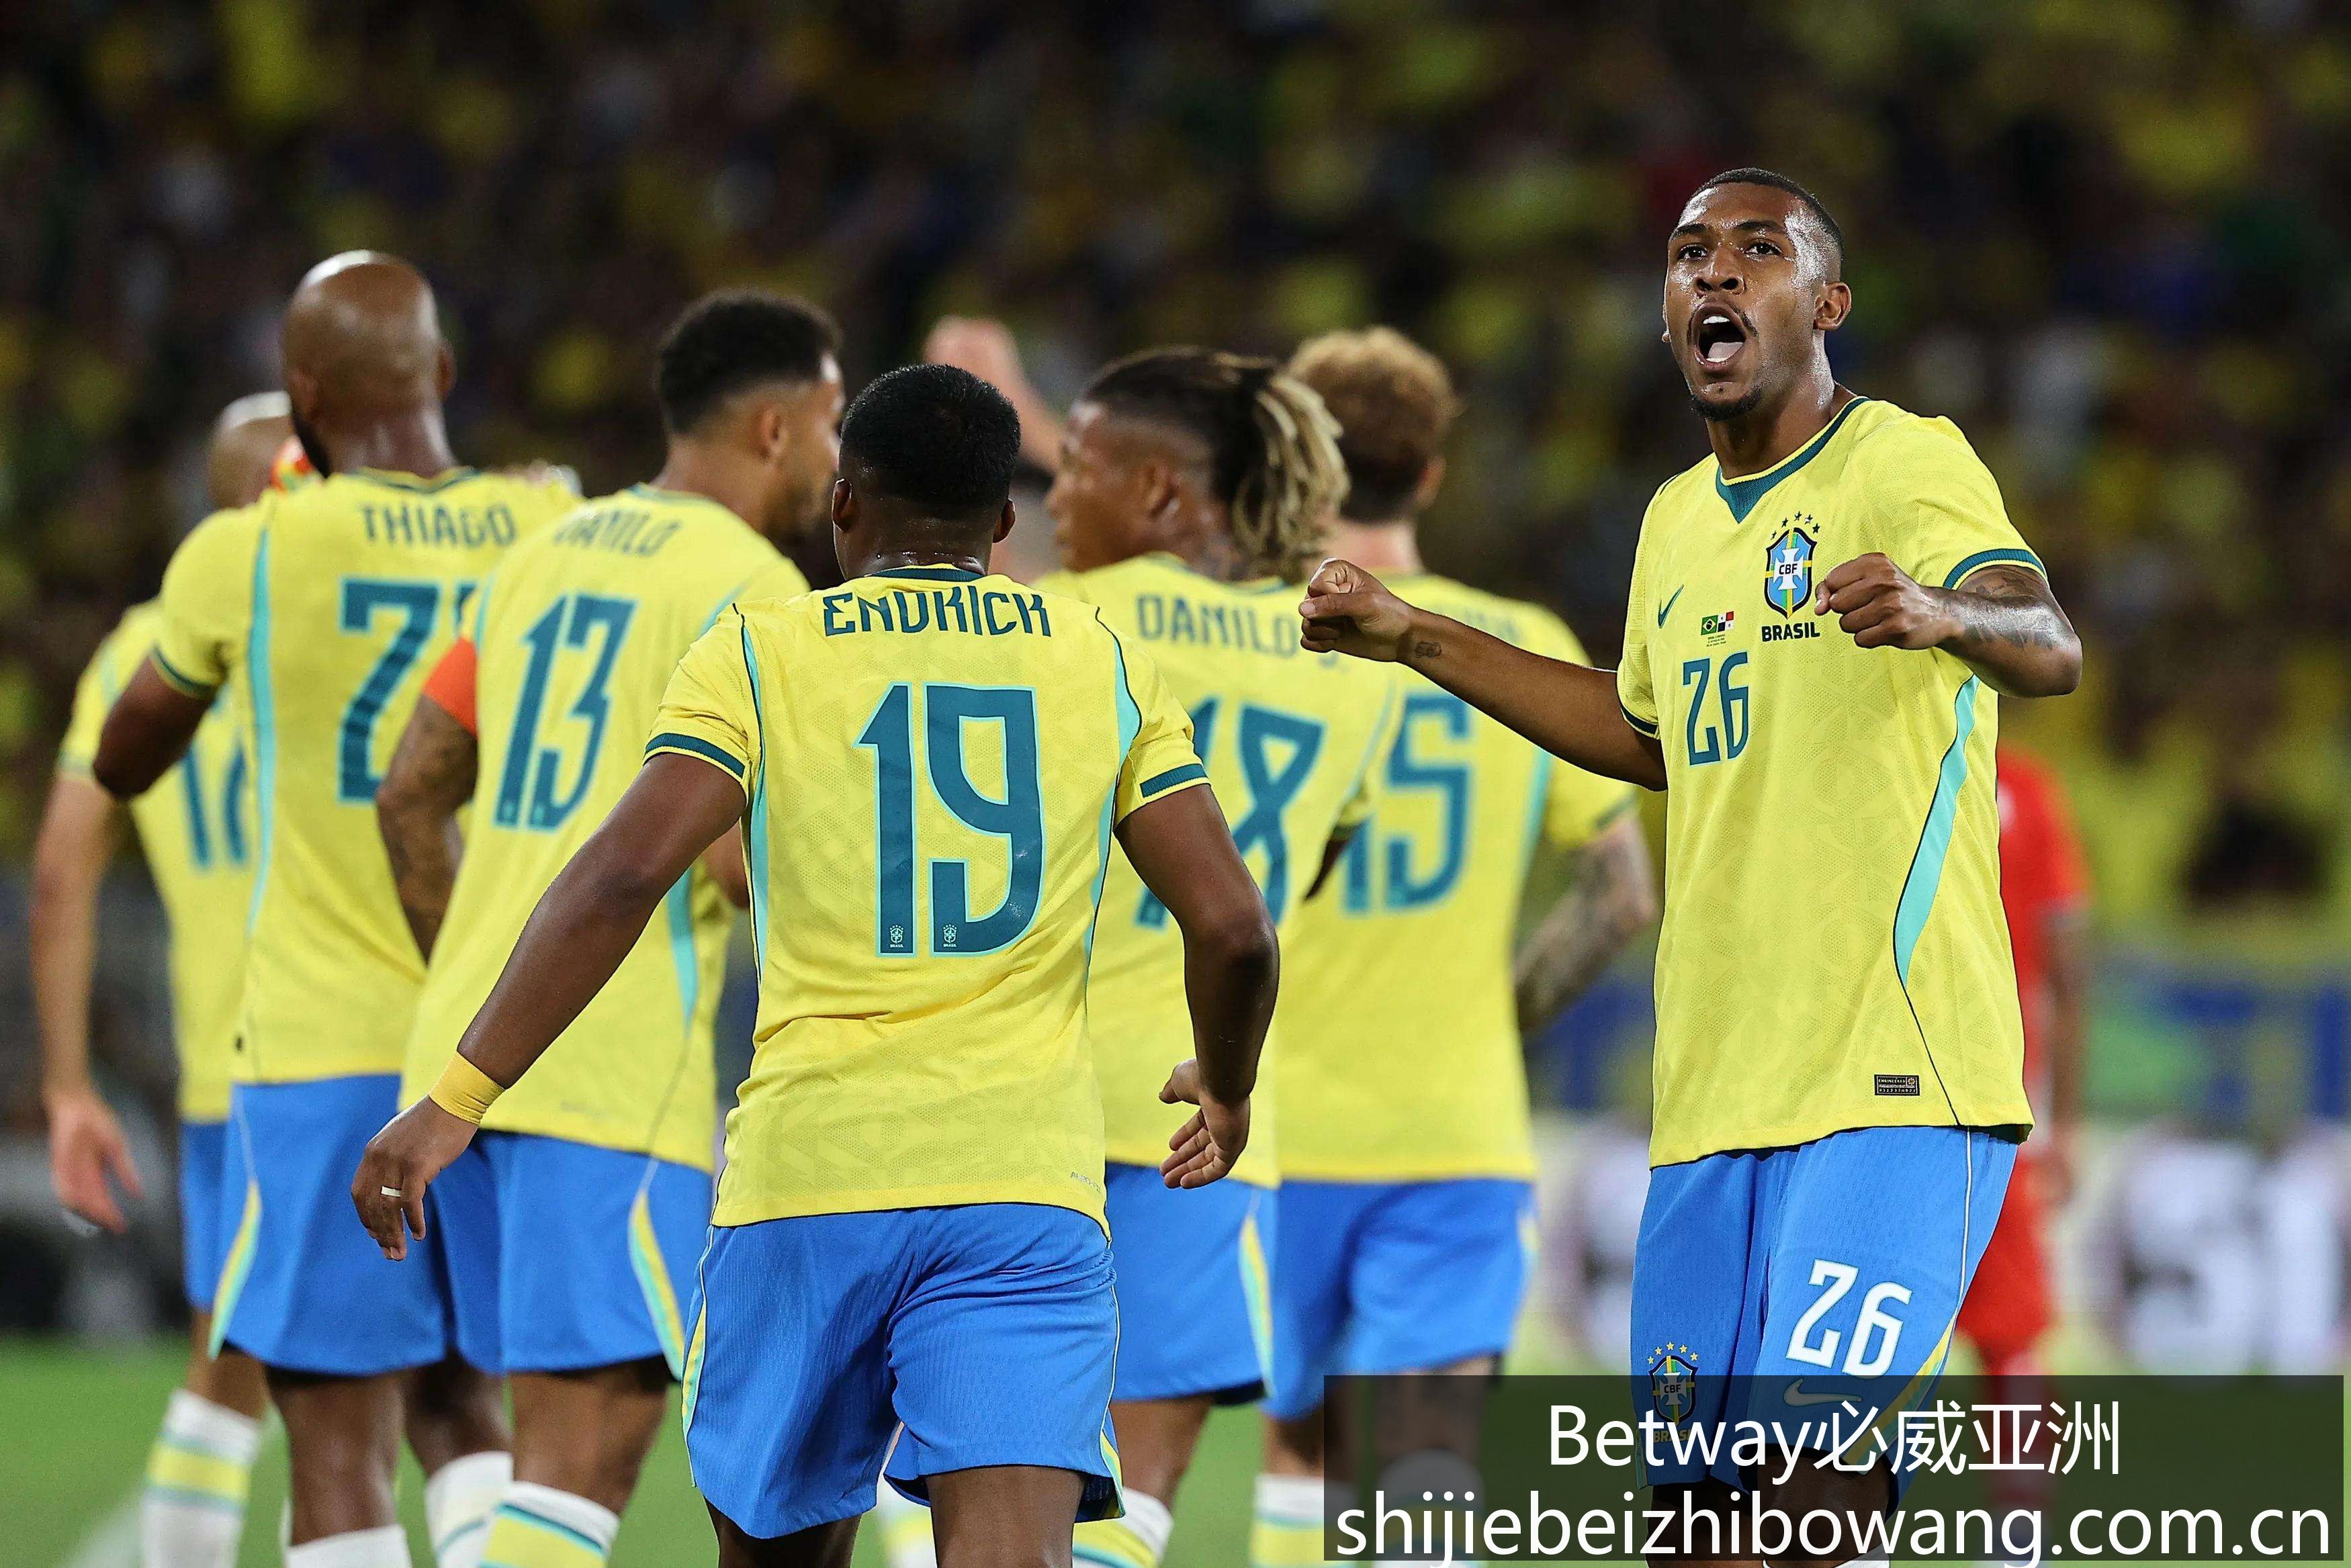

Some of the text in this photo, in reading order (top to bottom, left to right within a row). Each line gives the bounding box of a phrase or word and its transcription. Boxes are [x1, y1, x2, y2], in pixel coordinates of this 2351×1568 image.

[360, 505, 517, 549] THIAGO
[1779, 563, 1798, 575] CBF
[823, 585, 1052, 638] ENDRICK
[1137, 594, 1298, 659] DANILO
[1761, 622, 1820, 642] BRASIL
[338, 576, 478, 804] 2
[491, 594, 641, 834] 13
[1681, 650, 1749, 766] 26
[852, 681, 1047, 958] 19
[1785, 1258, 1914, 1380] 26
[1664, 1384, 1681, 1393] CBF
[1653, 1429, 1693, 1443] BRSI
